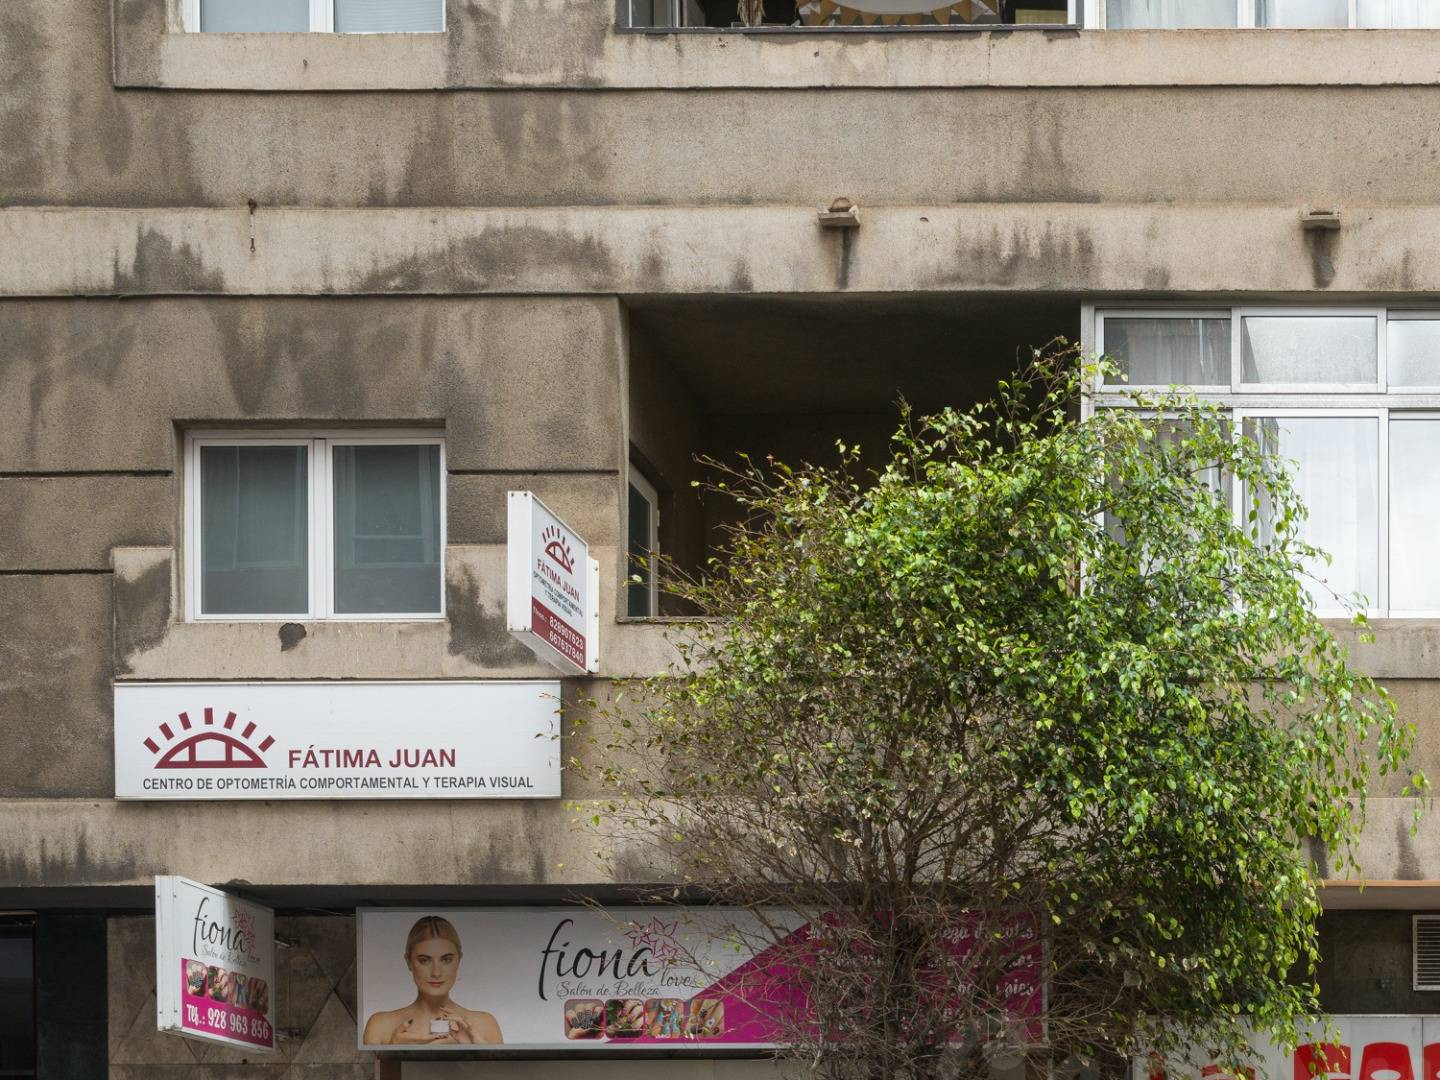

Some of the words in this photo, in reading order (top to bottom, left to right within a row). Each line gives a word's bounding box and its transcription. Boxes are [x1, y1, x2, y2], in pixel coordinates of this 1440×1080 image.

[537, 558, 562, 587] FÁTIMA
[562, 581, 580, 603] JUAN
[549, 615, 584, 650] 828907623
[288, 744, 382, 768] FÁTIMA
[388, 748, 456, 768] JUAN
[142, 777, 194, 791] CENTRO
[197, 777, 214, 790] DE
[216, 775, 296, 790] OPTOMETRÍA
[299, 776, 419, 790] COMPORTAMENTAL
[422, 776, 430, 789] Y
[433, 776, 487, 789] TERAPIA
[489, 775, 534, 788] VISUAL
[193, 896, 248, 957] fiona
[538, 918, 660, 1001] fiona
[556, 980, 592, 998] Salón
[596, 979, 610, 996] de
[614, 979, 661, 998] Belleza
[208, 1007, 227, 1030] 928
[230, 1012, 248, 1036] 963
[251, 1017, 269, 1041] 856
